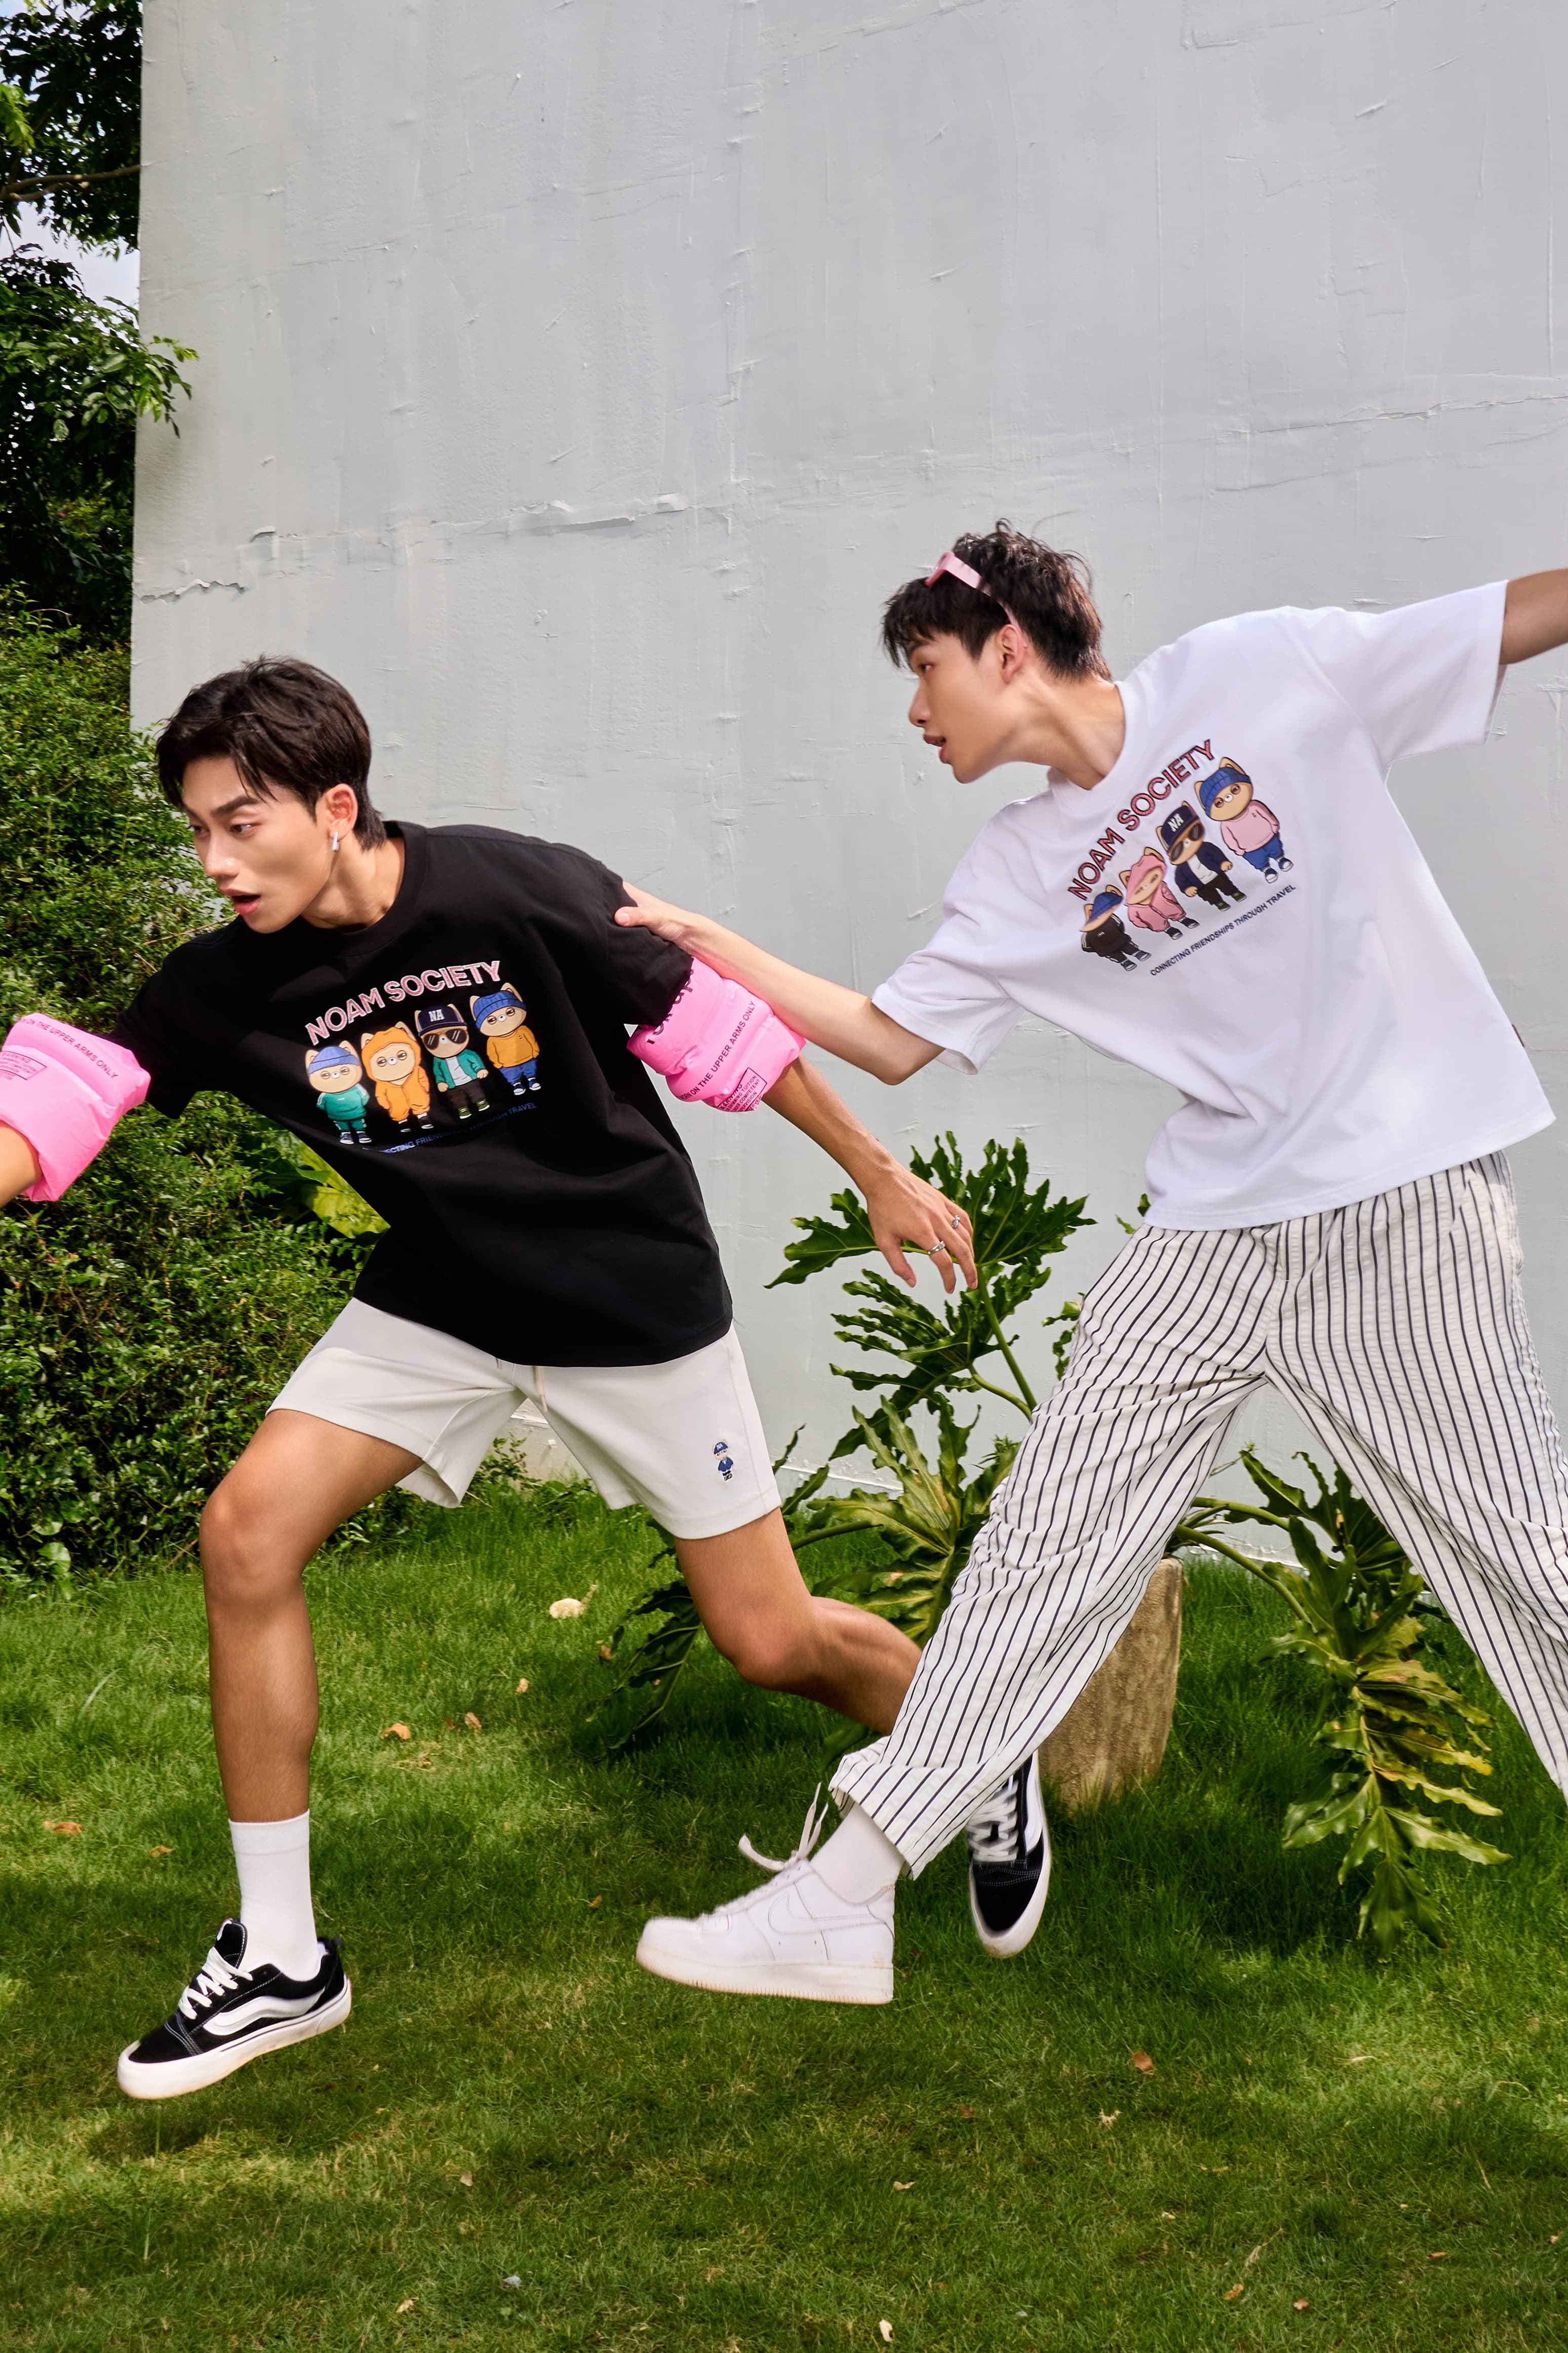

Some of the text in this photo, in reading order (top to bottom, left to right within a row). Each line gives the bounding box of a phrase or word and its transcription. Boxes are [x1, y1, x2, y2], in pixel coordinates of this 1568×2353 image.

[1068, 739, 1214, 901] NOAM SOCIETY
[1167, 813, 1184, 832] NA
[1151, 884, 1296, 976] CONNECTING FRIENDSHIPS THROUGH TRAVEL
[305, 960, 500, 1046] NOAM SOCIETY
[428, 1009, 445, 1022] NA
[36, 1021, 51, 1030] THE
[50, 1027, 75, 1045] UPPER
[74, 1043, 97, 1061] ARMS
[97, 1060, 119, 1078] ONLY
[690, 1086, 700, 1095] ON
[698, 1072, 713, 1087] THE
[711, 1045, 732, 1072] UPPER
[730, 1021, 746, 1045] ARMS
[742, 1000, 756, 1021] ONLY
[739, 1079, 760, 1104] COMPETENT
[741, 1075, 757, 1092] TUITION
[508, 1102, 537, 1114] TRAVEL
